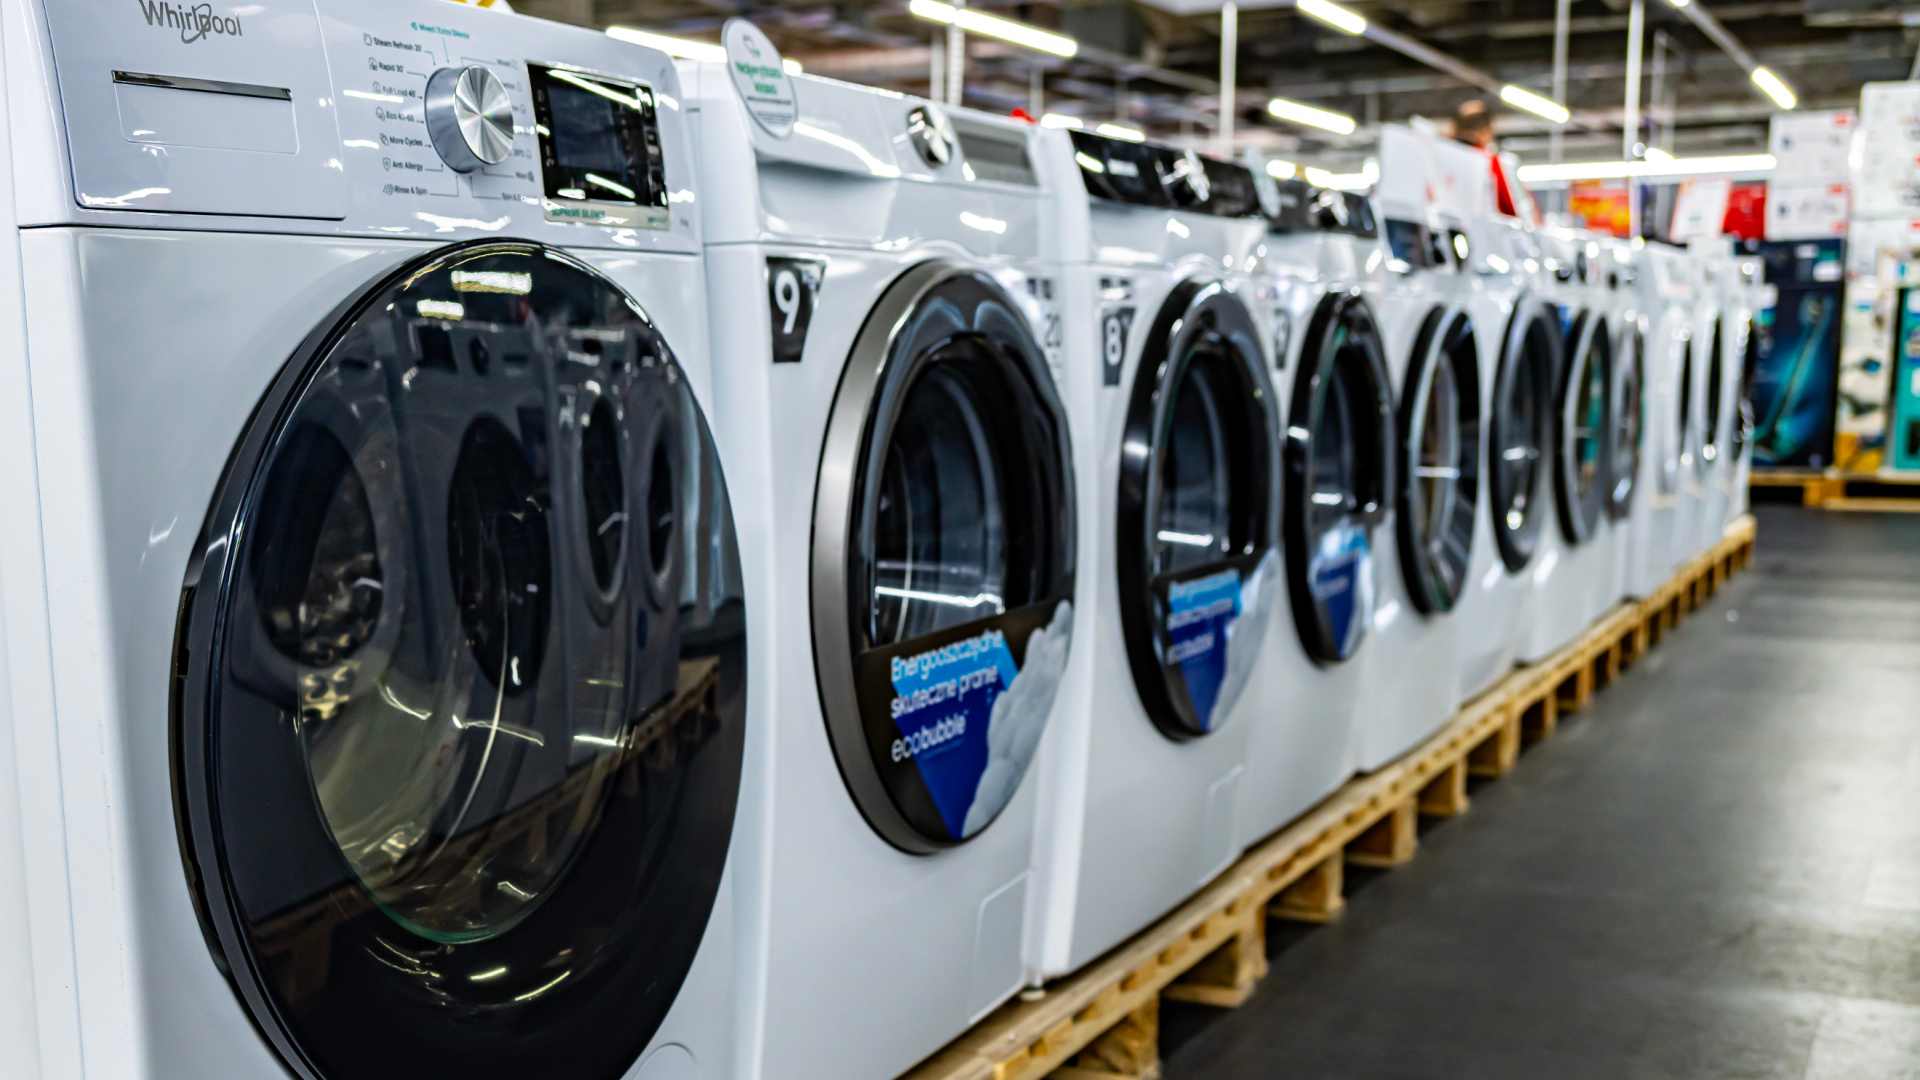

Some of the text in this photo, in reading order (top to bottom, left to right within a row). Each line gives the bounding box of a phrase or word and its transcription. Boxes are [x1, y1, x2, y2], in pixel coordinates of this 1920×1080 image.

[138, 0, 242, 44] Whirlpool
[373, 37, 392, 48] Steam
[392, 40, 414, 51] Refresh
[378, 62, 395, 72] Rapid
[382, 86, 393, 95] Full
[386, 111, 397, 120] Eco
[389, 136, 423, 147] More Cycles
[392, 161, 423, 172] Anti Allergy
[394, 185, 410, 194] Rinse
[415, 187, 428, 195] Spin
[774, 270, 801, 335] 9
[1105, 316, 1122, 367] 8
[891, 665, 998, 720] skuteczne pranie
